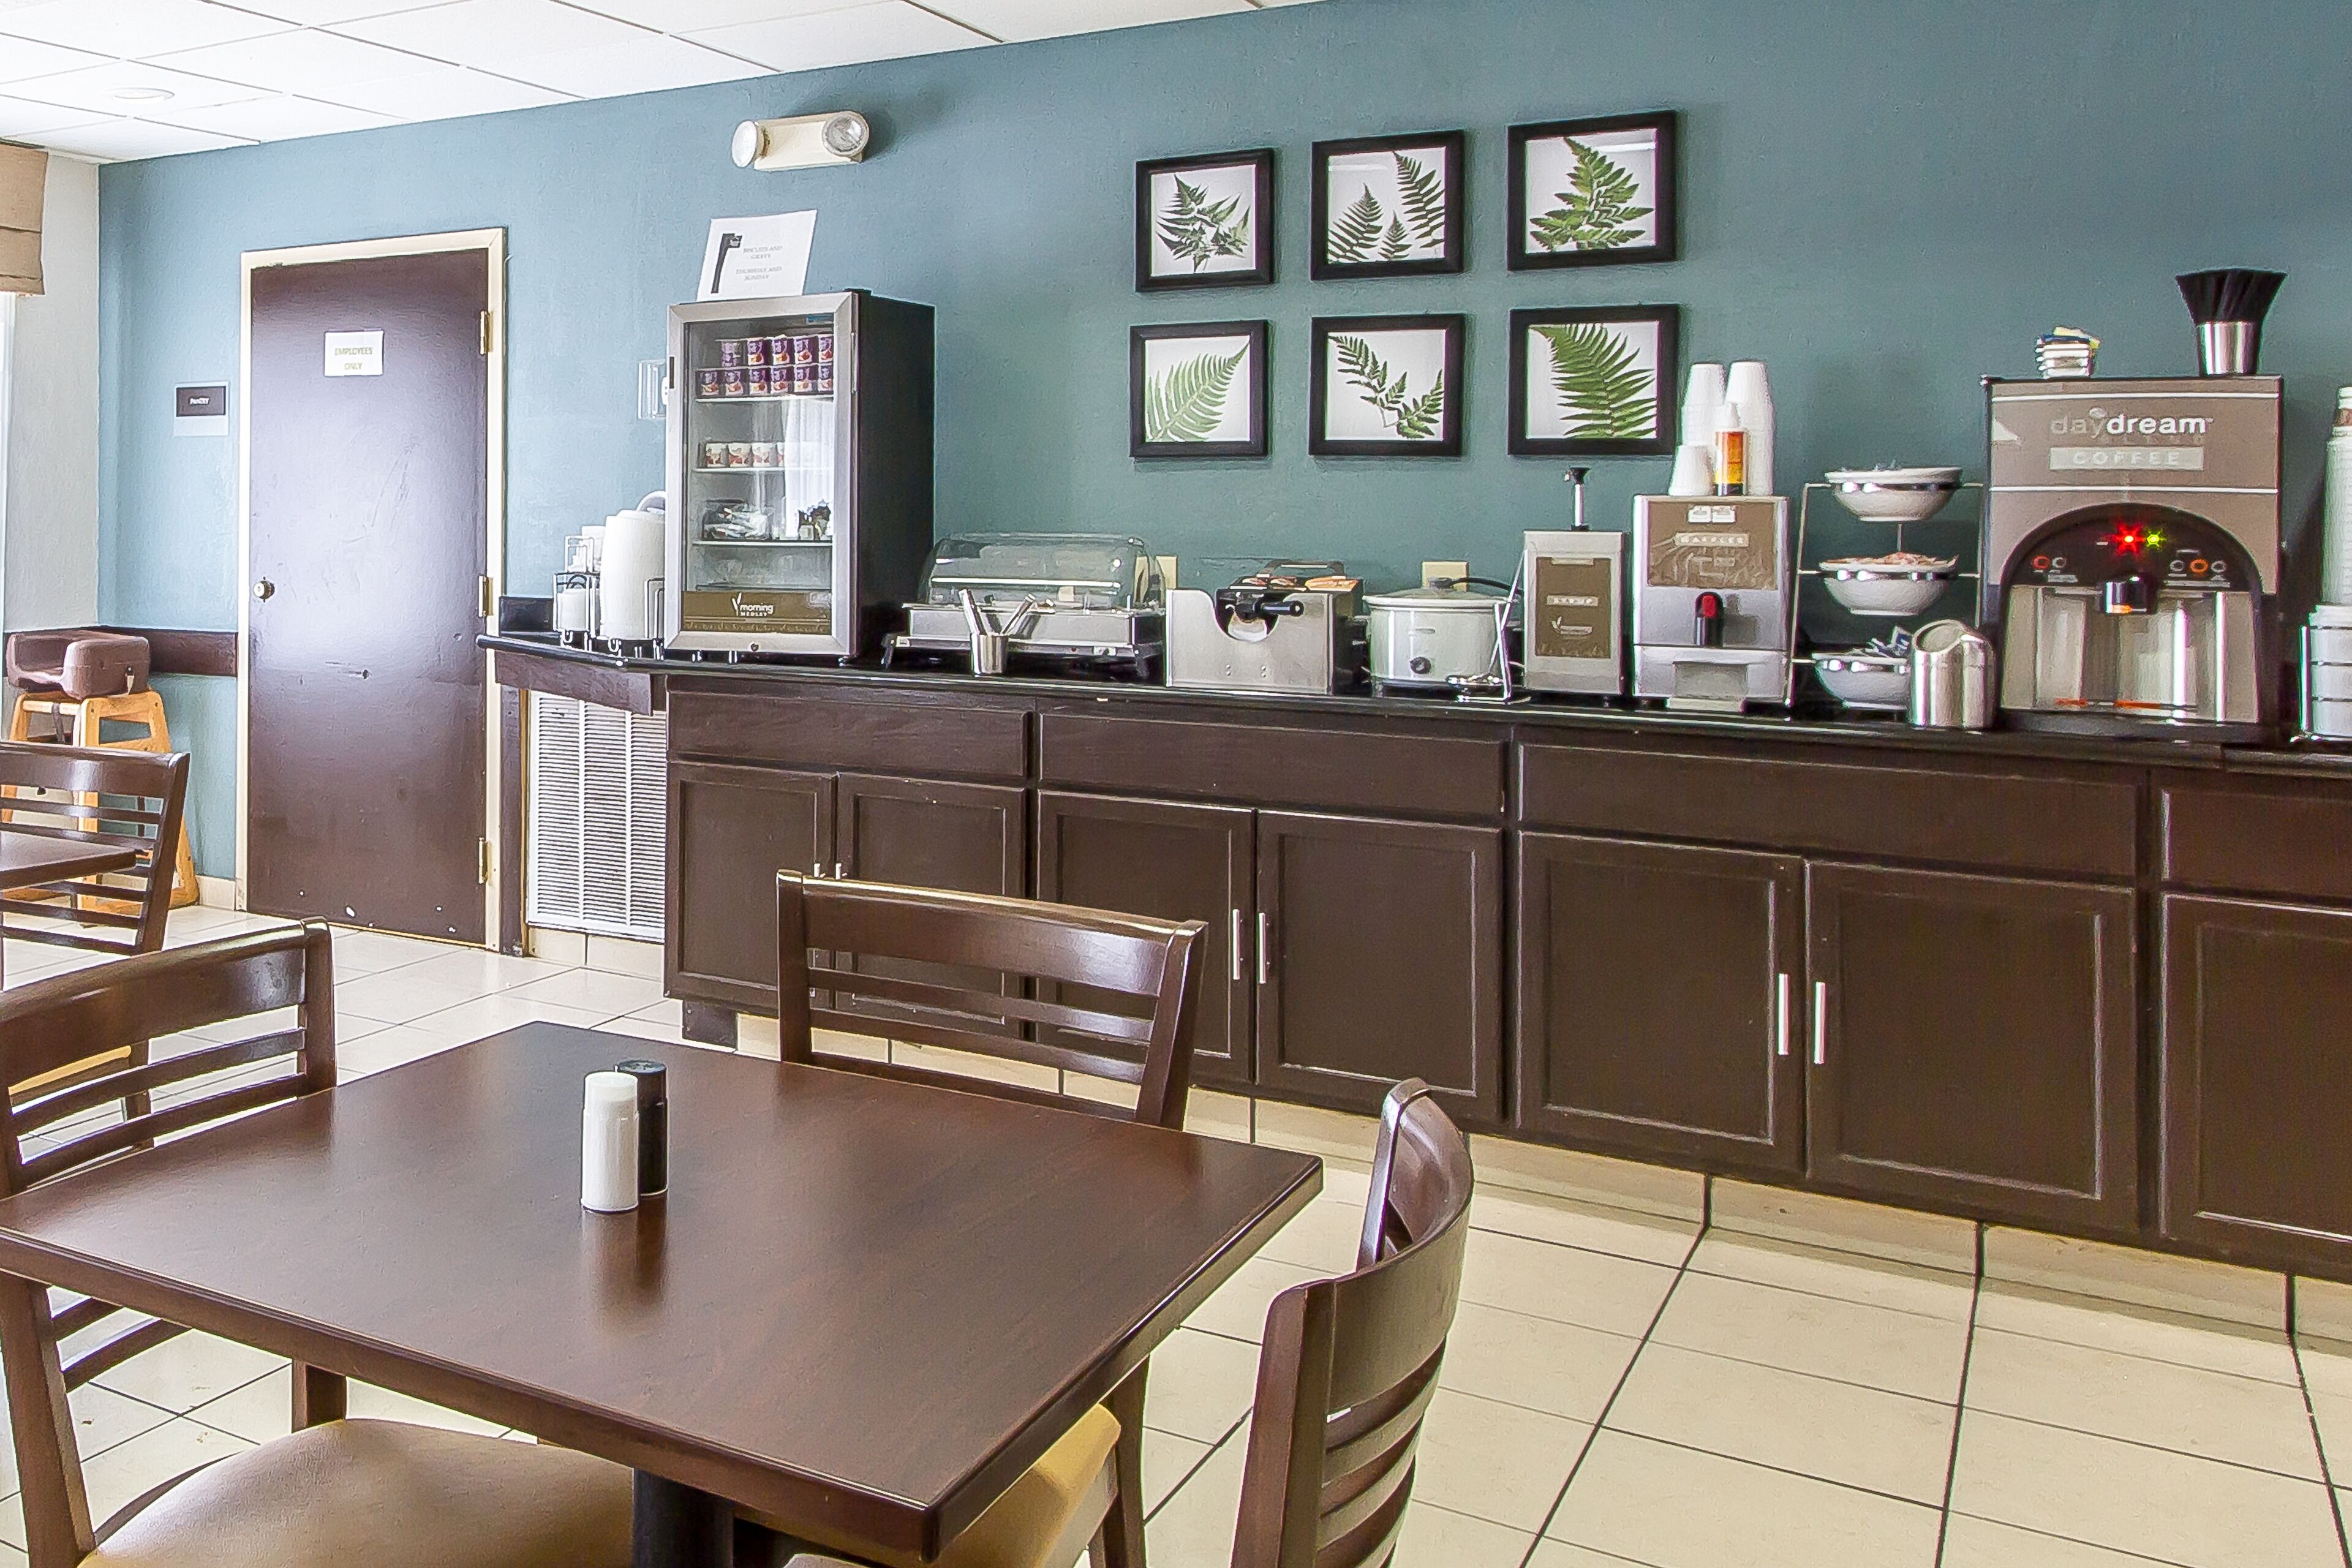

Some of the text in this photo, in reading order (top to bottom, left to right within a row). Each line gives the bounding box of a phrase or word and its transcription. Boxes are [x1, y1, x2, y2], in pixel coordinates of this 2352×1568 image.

[334, 347, 372, 356] EMPLOYEES
[2050, 409, 2207, 439] daydream
[2072, 451, 2180, 466] COFFEE
[740, 603, 774, 614] morning
